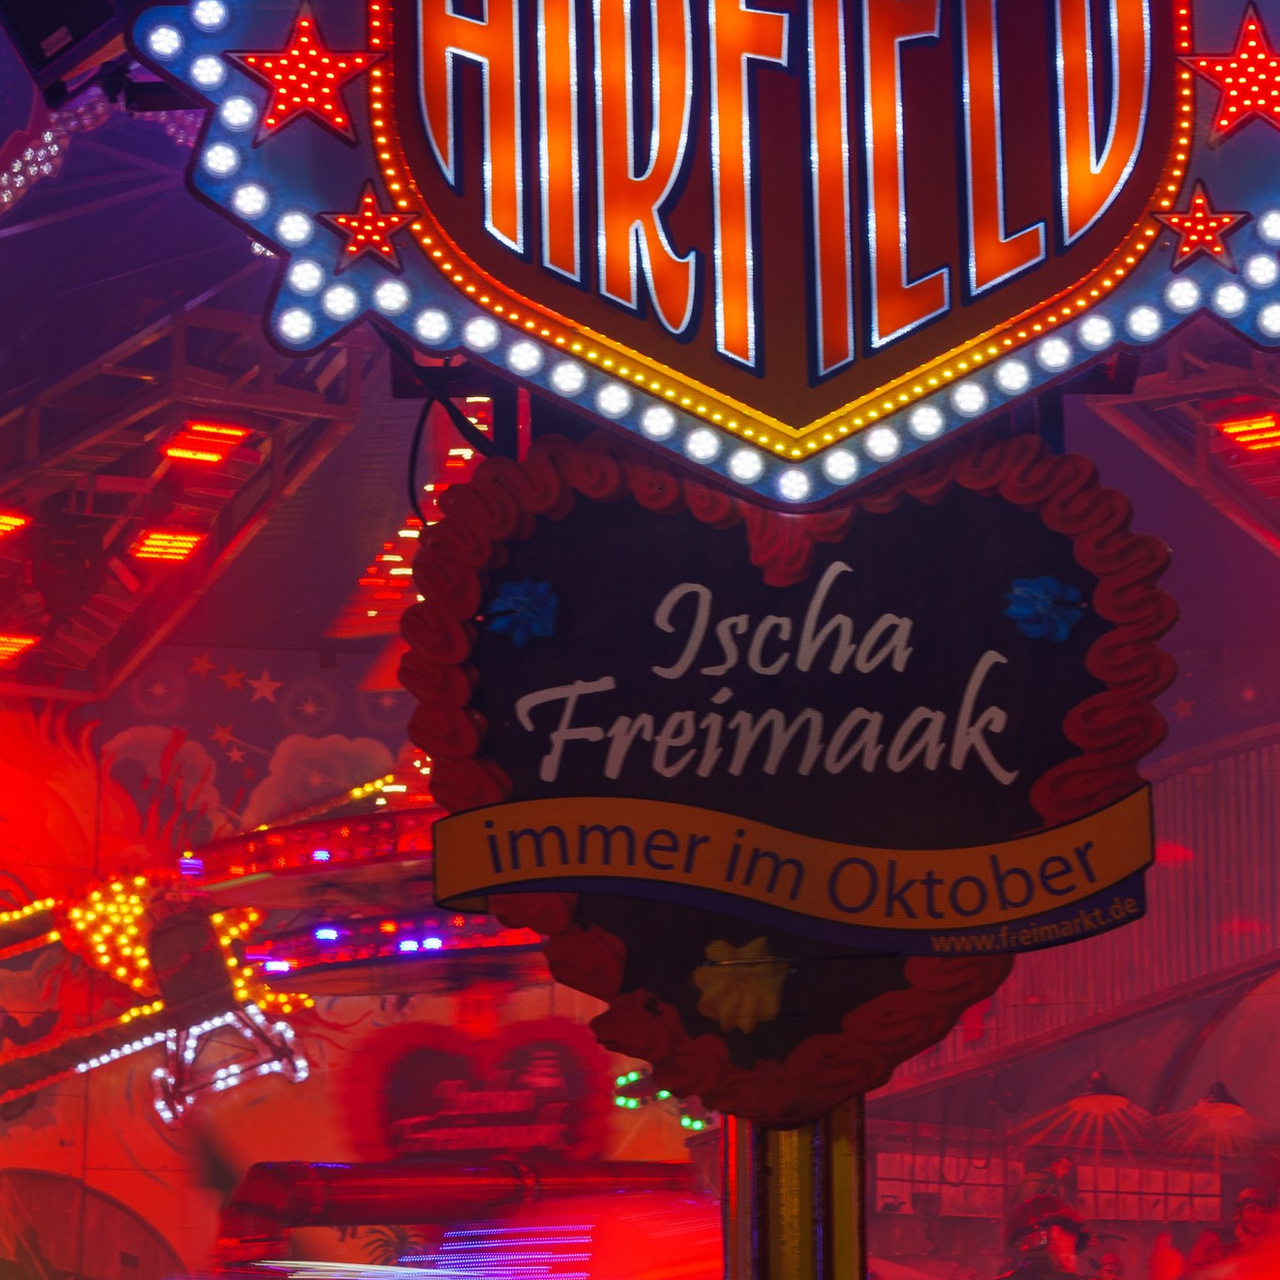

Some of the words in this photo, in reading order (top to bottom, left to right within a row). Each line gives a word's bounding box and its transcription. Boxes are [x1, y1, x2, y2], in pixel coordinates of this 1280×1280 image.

[652, 562, 913, 679] Ischa
[514, 650, 1018, 784] Freimaak
[484, 821, 709, 874] immer
[724, 830, 805, 900] im
[827, 838, 1096, 919] Oktober
[930, 896, 1140, 952] www.freimarkt.de
